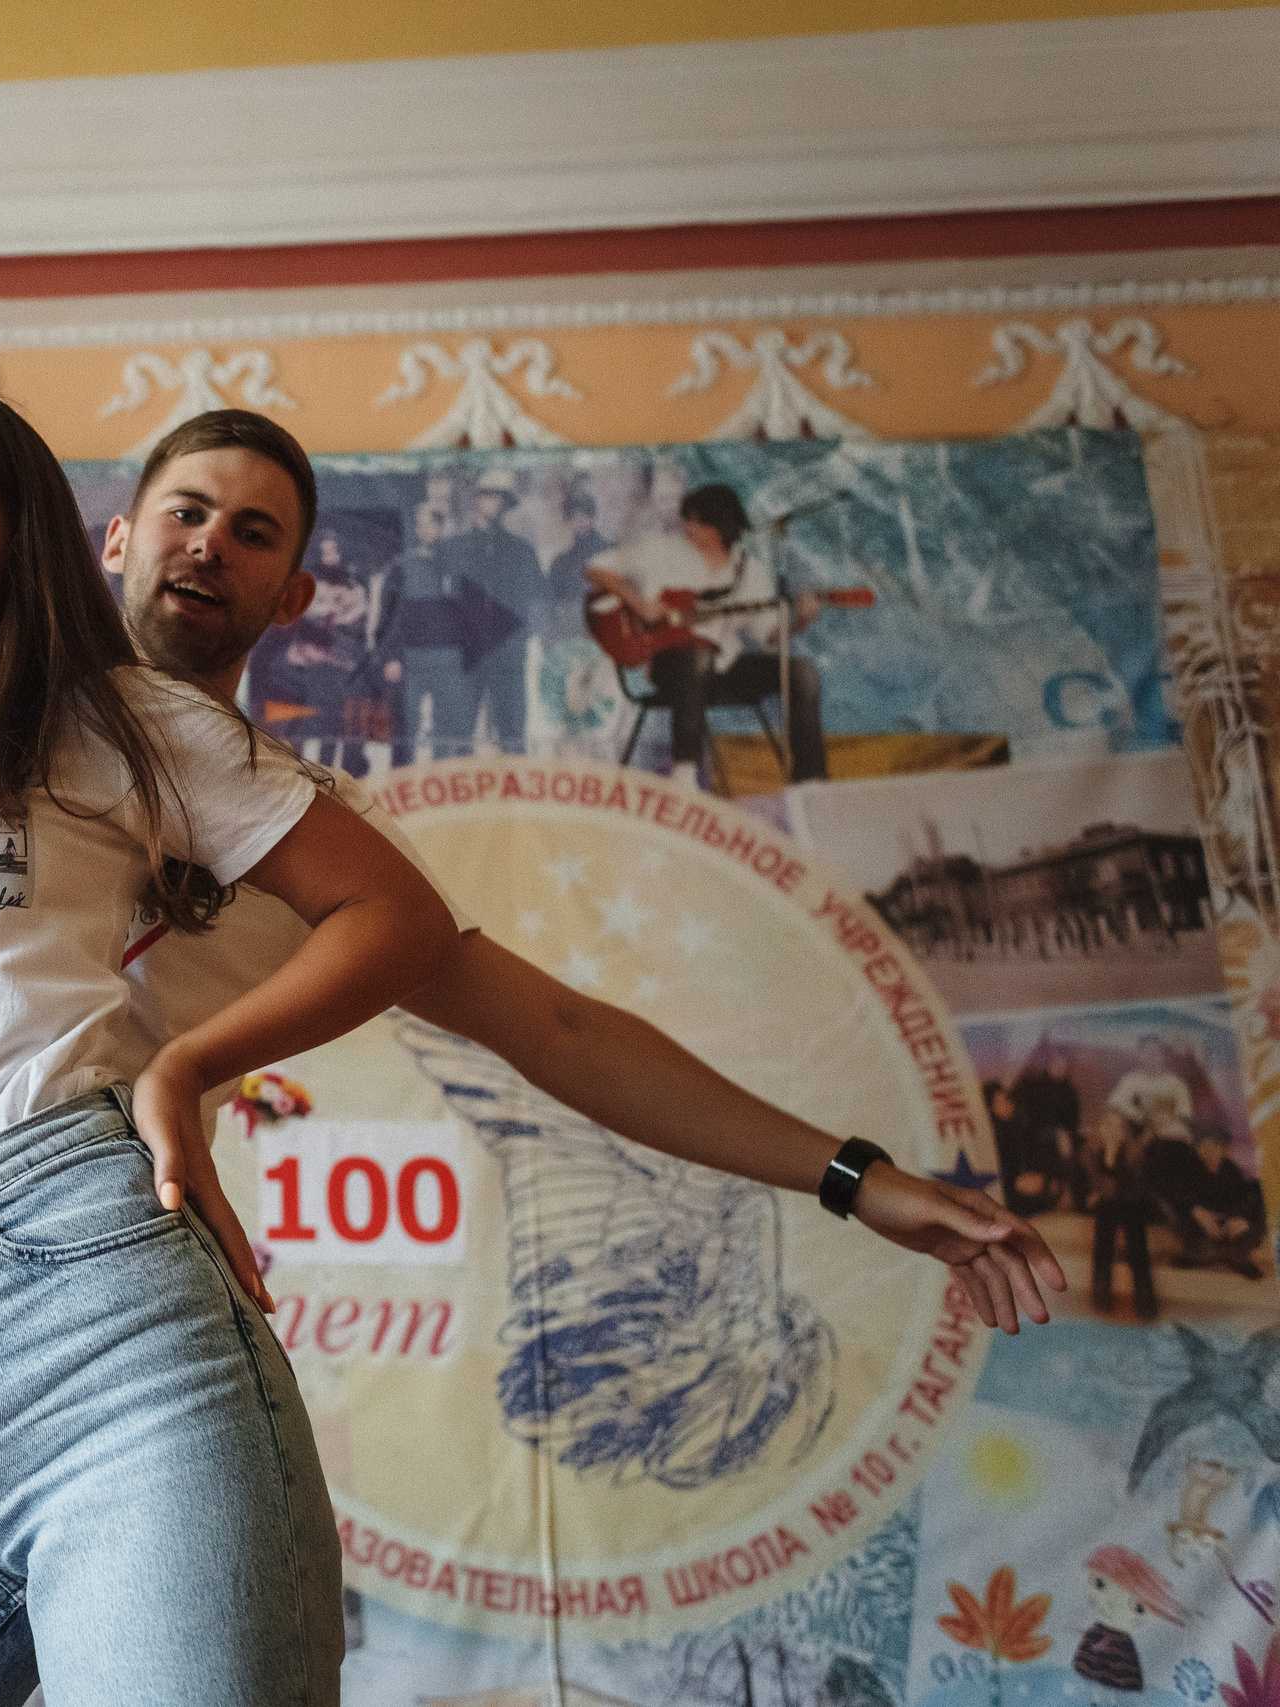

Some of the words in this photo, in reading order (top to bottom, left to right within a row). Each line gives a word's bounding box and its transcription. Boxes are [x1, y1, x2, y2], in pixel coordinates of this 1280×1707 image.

[811, 891, 975, 1142] УЧРЕЖДЕНИЕ
[265, 1156, 460, 1245] 100
[335, 1512, 650, 1620] АЗОВАТЕЛЬНАЯ
[664, 1525, 810, 1608] ШКОЛА
[850, 1449, 897, 1499] 10
